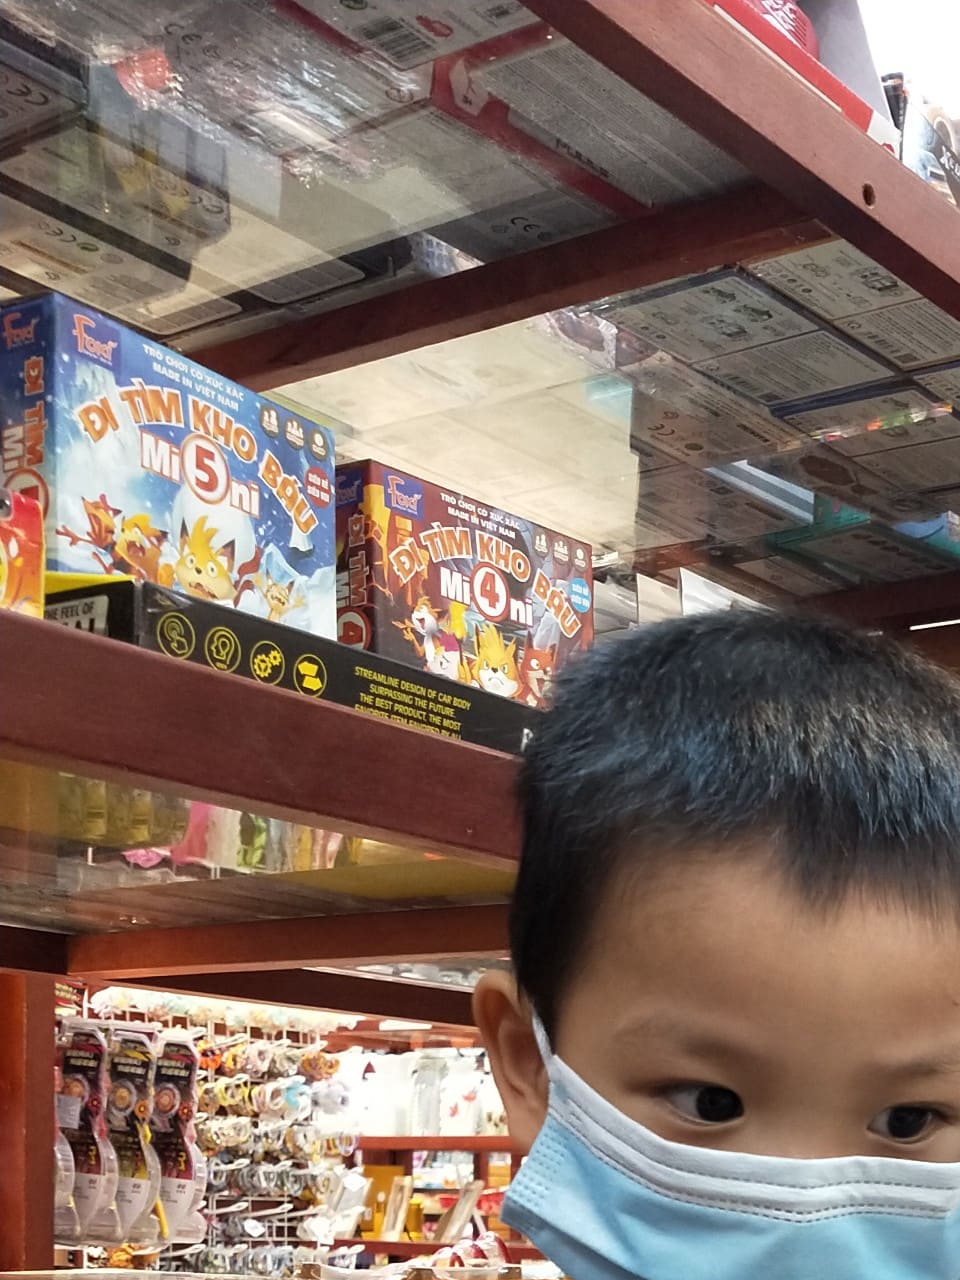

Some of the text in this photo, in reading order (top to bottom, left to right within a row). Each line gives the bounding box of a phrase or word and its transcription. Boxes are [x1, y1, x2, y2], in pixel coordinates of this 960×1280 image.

[152, 361, 181, 383] MADE
[182, 376, 193, 391] IN
[217, 394, 239, 412] NAM
[75, 395, 120, 443] ĐI
[119, 378, 185, 427] TÌM
[187, 394, 258, 463] KHO
[258, 449, 320, 535] BÁU
[447, 506, 470, 523] MADE
[470, 515, 480, 526] IN
[499, 526, 516, 540] NAM
[388, 537, 425, 584] ĐI
[419, 521, 473, 563] TÌM
[475, 529, 532, 583] KHO
[532, 568, 582, 639] BÁU
[61, 602, 80, 619] FEEL
[82, 600, 95, 614] OF
[354, 666, 472, 711] STREAMLINE DESIGN OF CAR BODY
[369, 683, 414, 706] SURPASSING
[414, 697, 428, 710] THE
[359, 692, 375, 706] THE
[374, 696, 393, 711] BEST
[428, 712, 443, 726] THE
[442, 718, 463, 731] MOST
